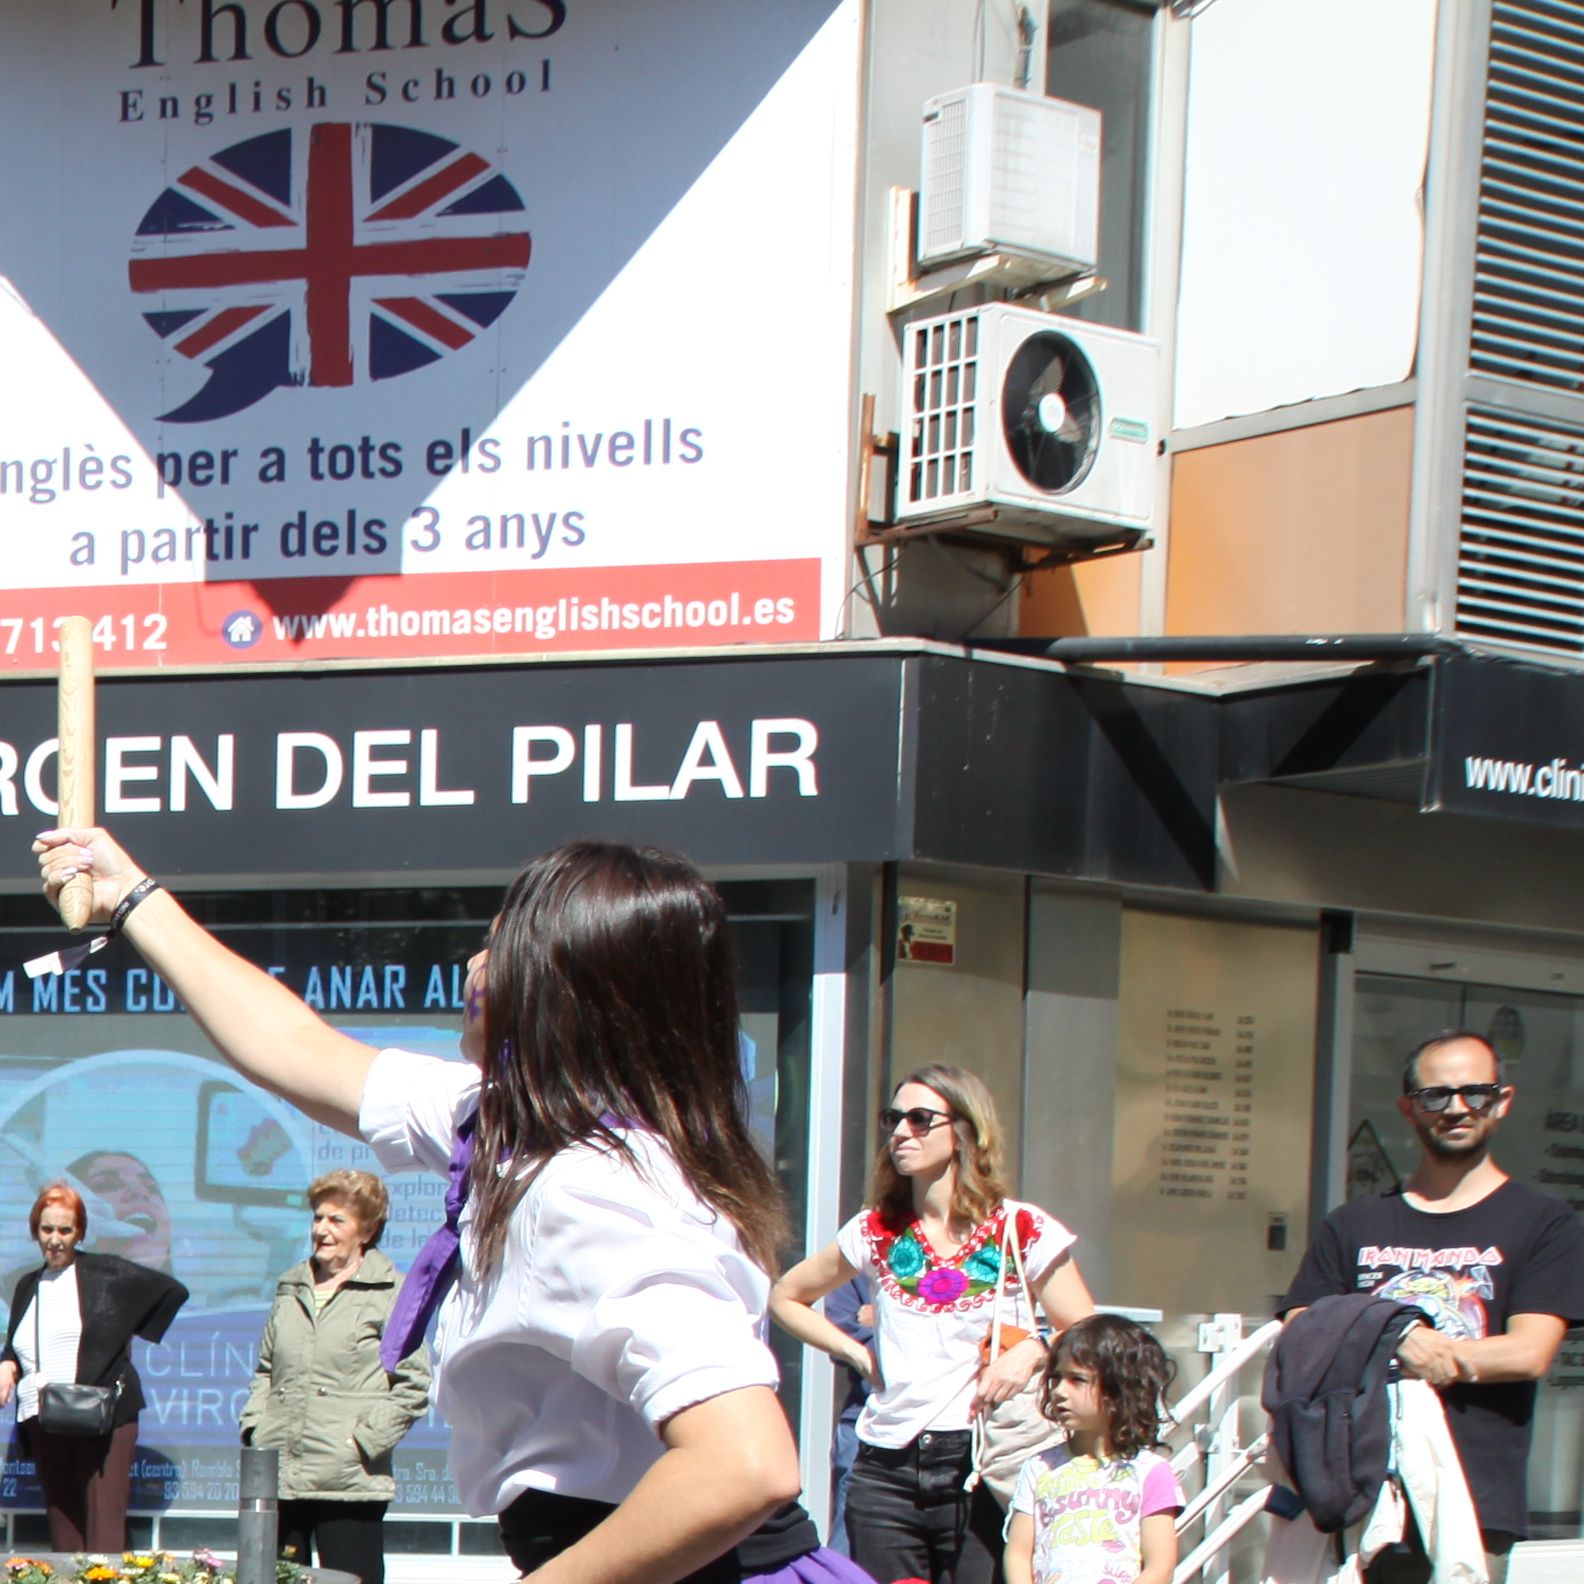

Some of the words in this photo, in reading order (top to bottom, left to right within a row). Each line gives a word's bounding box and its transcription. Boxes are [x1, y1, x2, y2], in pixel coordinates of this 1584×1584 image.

[119, 77, 327, 124] English
[365, 59, 551, 106] School
[157, 448, 237, 499] per
[258, 446, 286, 483] a
[307, 434, 404, 481] tots
[426, 427, 502, 476] els
[526, 417, 705, 471] nivells
[70, 532, 96, 566] a
[120, 512, 259, 576] partir
[280, 509, 388, 561] dels
[410, 507, 441, 552] 3
[464, 509, 587, 560] anys
[91, 612, 168, 652] 412
[273, 592, 795, 641] www.thomasenglishschool.es
[275, 728, 475, 811] DEL
[511, 717, 818, 805] PILAR
[33, 969, 107, 1012] MES
[304, 966, 406, 1009] ANAR
[144, 1331, 254, 1377] CLÍN
